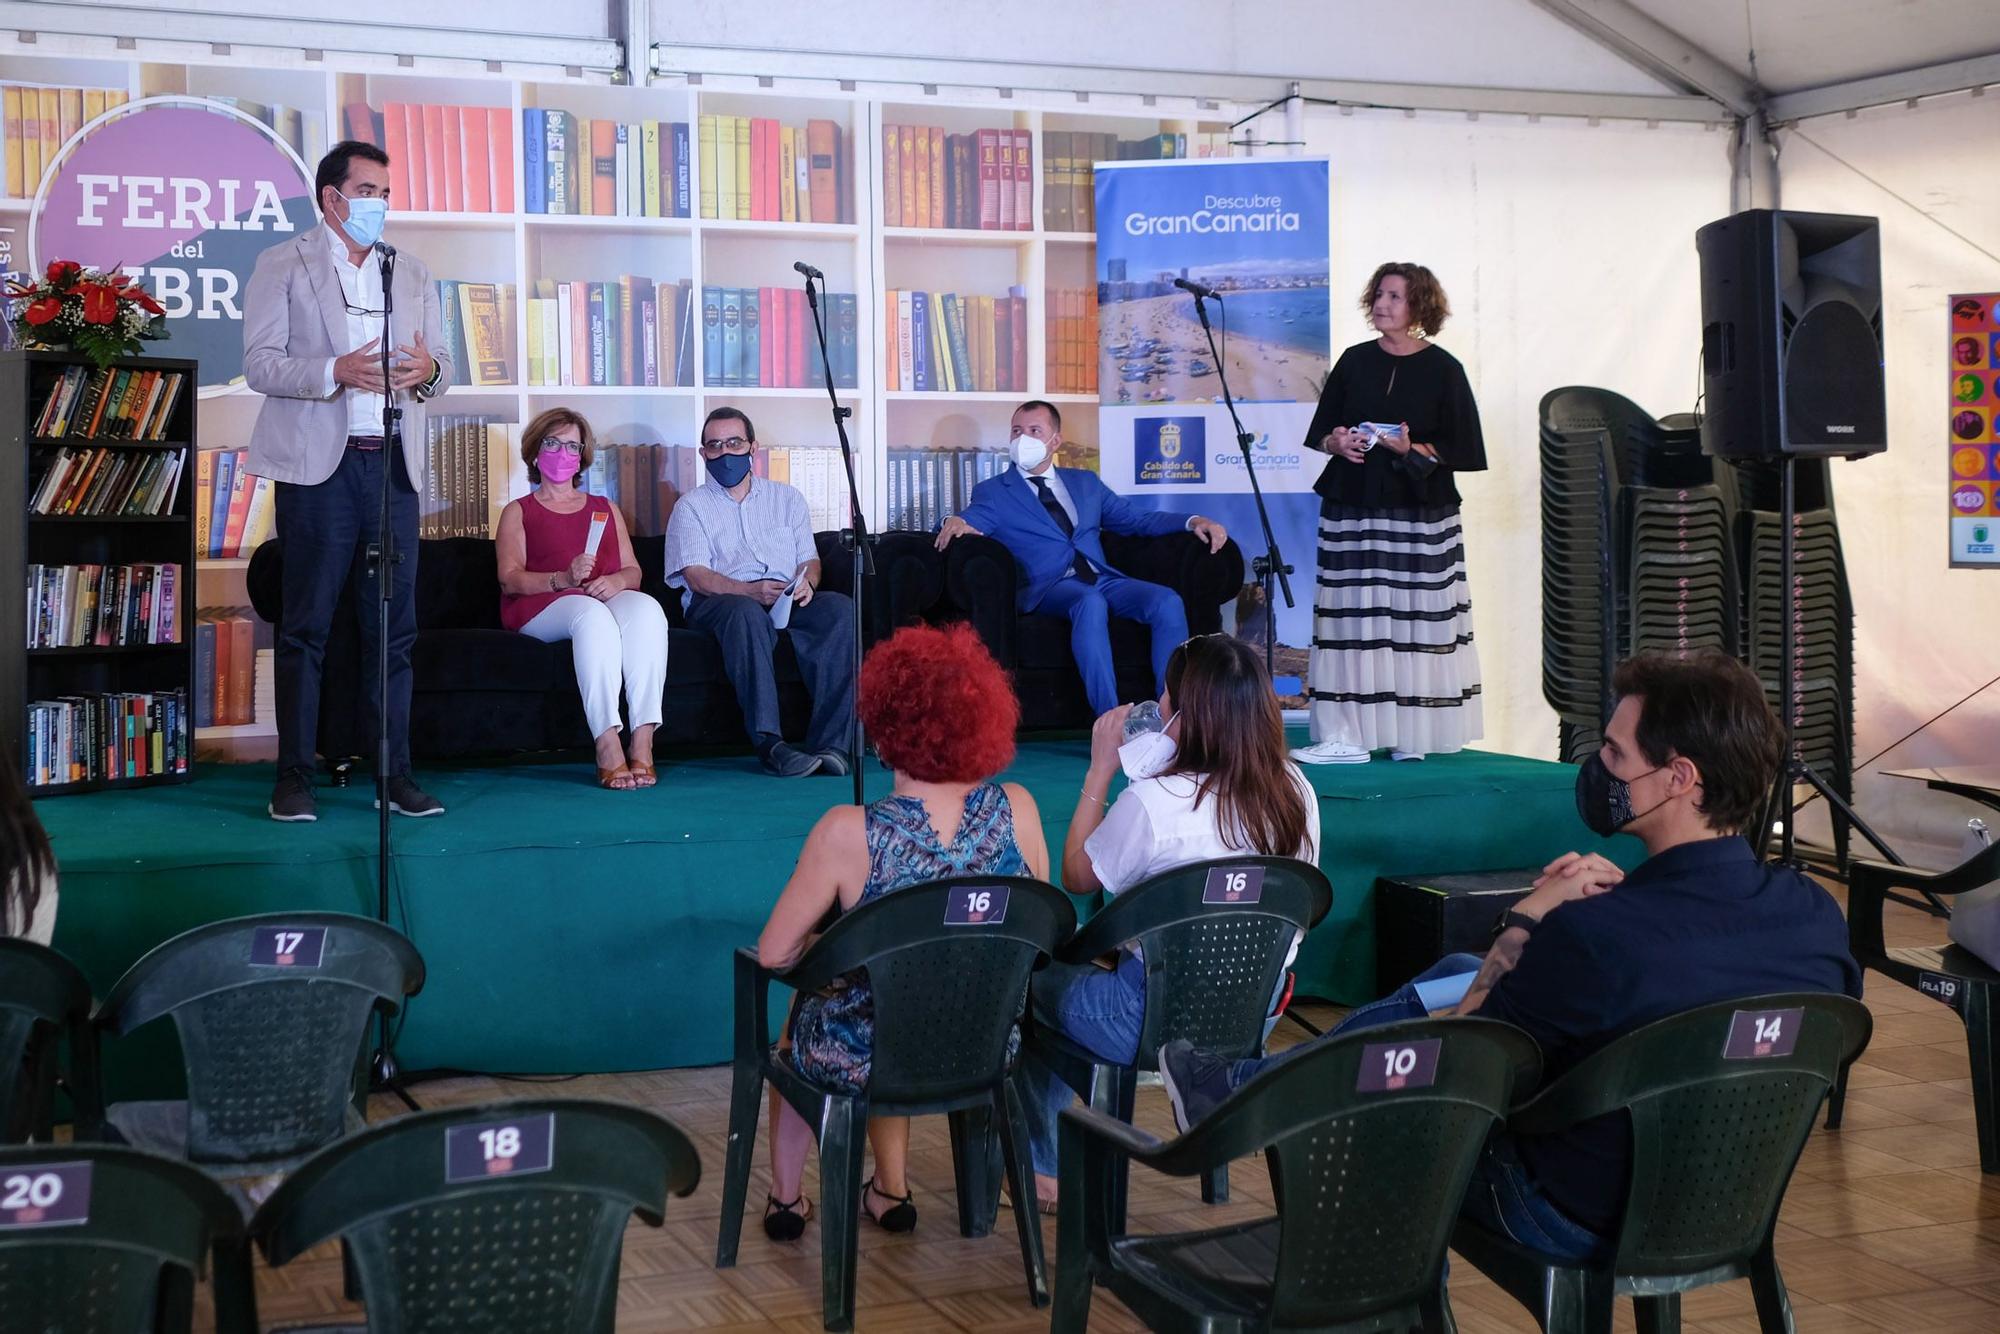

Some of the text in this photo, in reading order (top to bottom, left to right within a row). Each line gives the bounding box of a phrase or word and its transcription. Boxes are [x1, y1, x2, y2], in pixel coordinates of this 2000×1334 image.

[76, 173, 295, 233] FERIA
[1204, 194, 1281, 210] Descubre
[1125, 208, 1300, 235] GranCanaria
[170, 240, 204, 259] del
[1826, 425, 1856, 433] WORK
[1144, 461, 1194, 470] Cabildo de
[1140, 470, 1201, 480] Gran Canaria
[427, 526, 439, 535] IV
[442, 525, 450, 534] V
[454, 528, 464, 537] VI
[466, 526, 479, 535] VII
[481, 523, 489, 532] IX
[1225, 872, 1248, 892] 16
[967, 891, 991, 912] 16
[274, 931, 304, 955] 17
[1921, 980, 1956, 997] FILA 19
[1754, 1016, 1783, 1043] 14
[1384, 1047, 1417, 1076] 10
[478, 1126, 521, 1161] 18
[2, 1172, 63, 1210] 20
